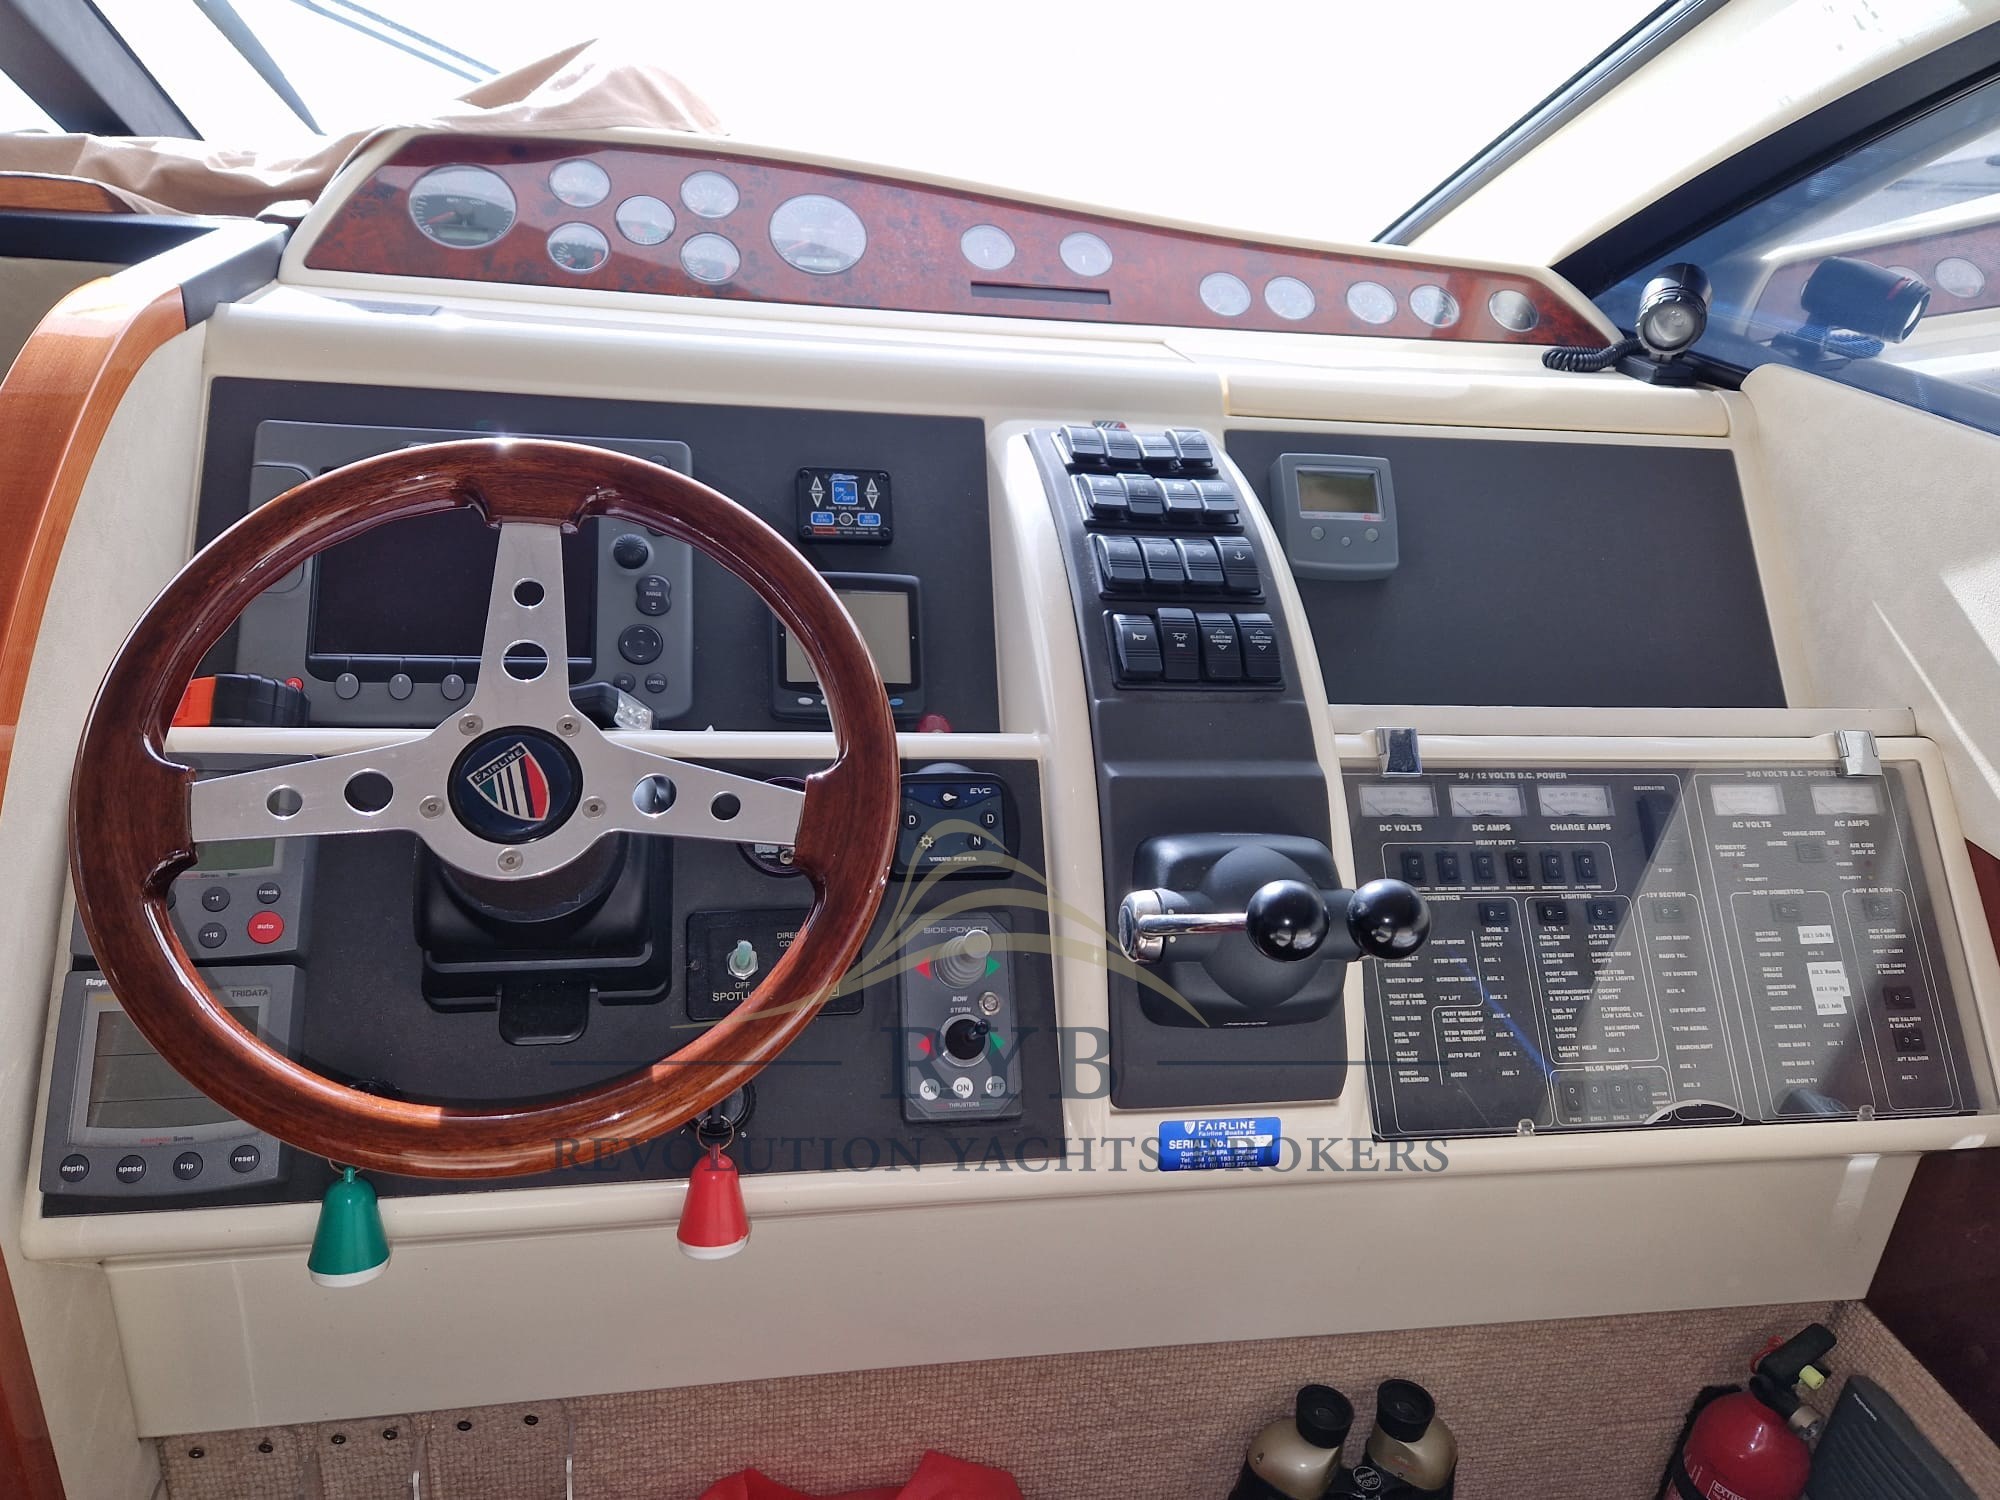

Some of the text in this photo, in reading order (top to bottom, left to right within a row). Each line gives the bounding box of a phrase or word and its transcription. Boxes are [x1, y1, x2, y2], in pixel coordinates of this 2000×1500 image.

[474, 748, 522, 782] FAIRLINE
[908, 815, 916, 825] D
[986, 814, 994, 824] D
[1487, 824, 1512, 832] AMPS
[974, 836, 981, 846] N
[230, 990, 268, 998] TRIDATA
[923, 1086, 937, 1094] ON
[956, 1084, 970, 1092] ON
[986, 1082, 1004, 1091] OFF
[1198, 1120, 1256, 1130] FAIRLINE
[1168, 1139, 1208, 1150] SERIAL
[234, 1155, 255, 1163] reset
[62, 1164, 84, 1173] depth
[118, 1164, 143, 1174] speed
[180, 1162, 194, 1170] trip
